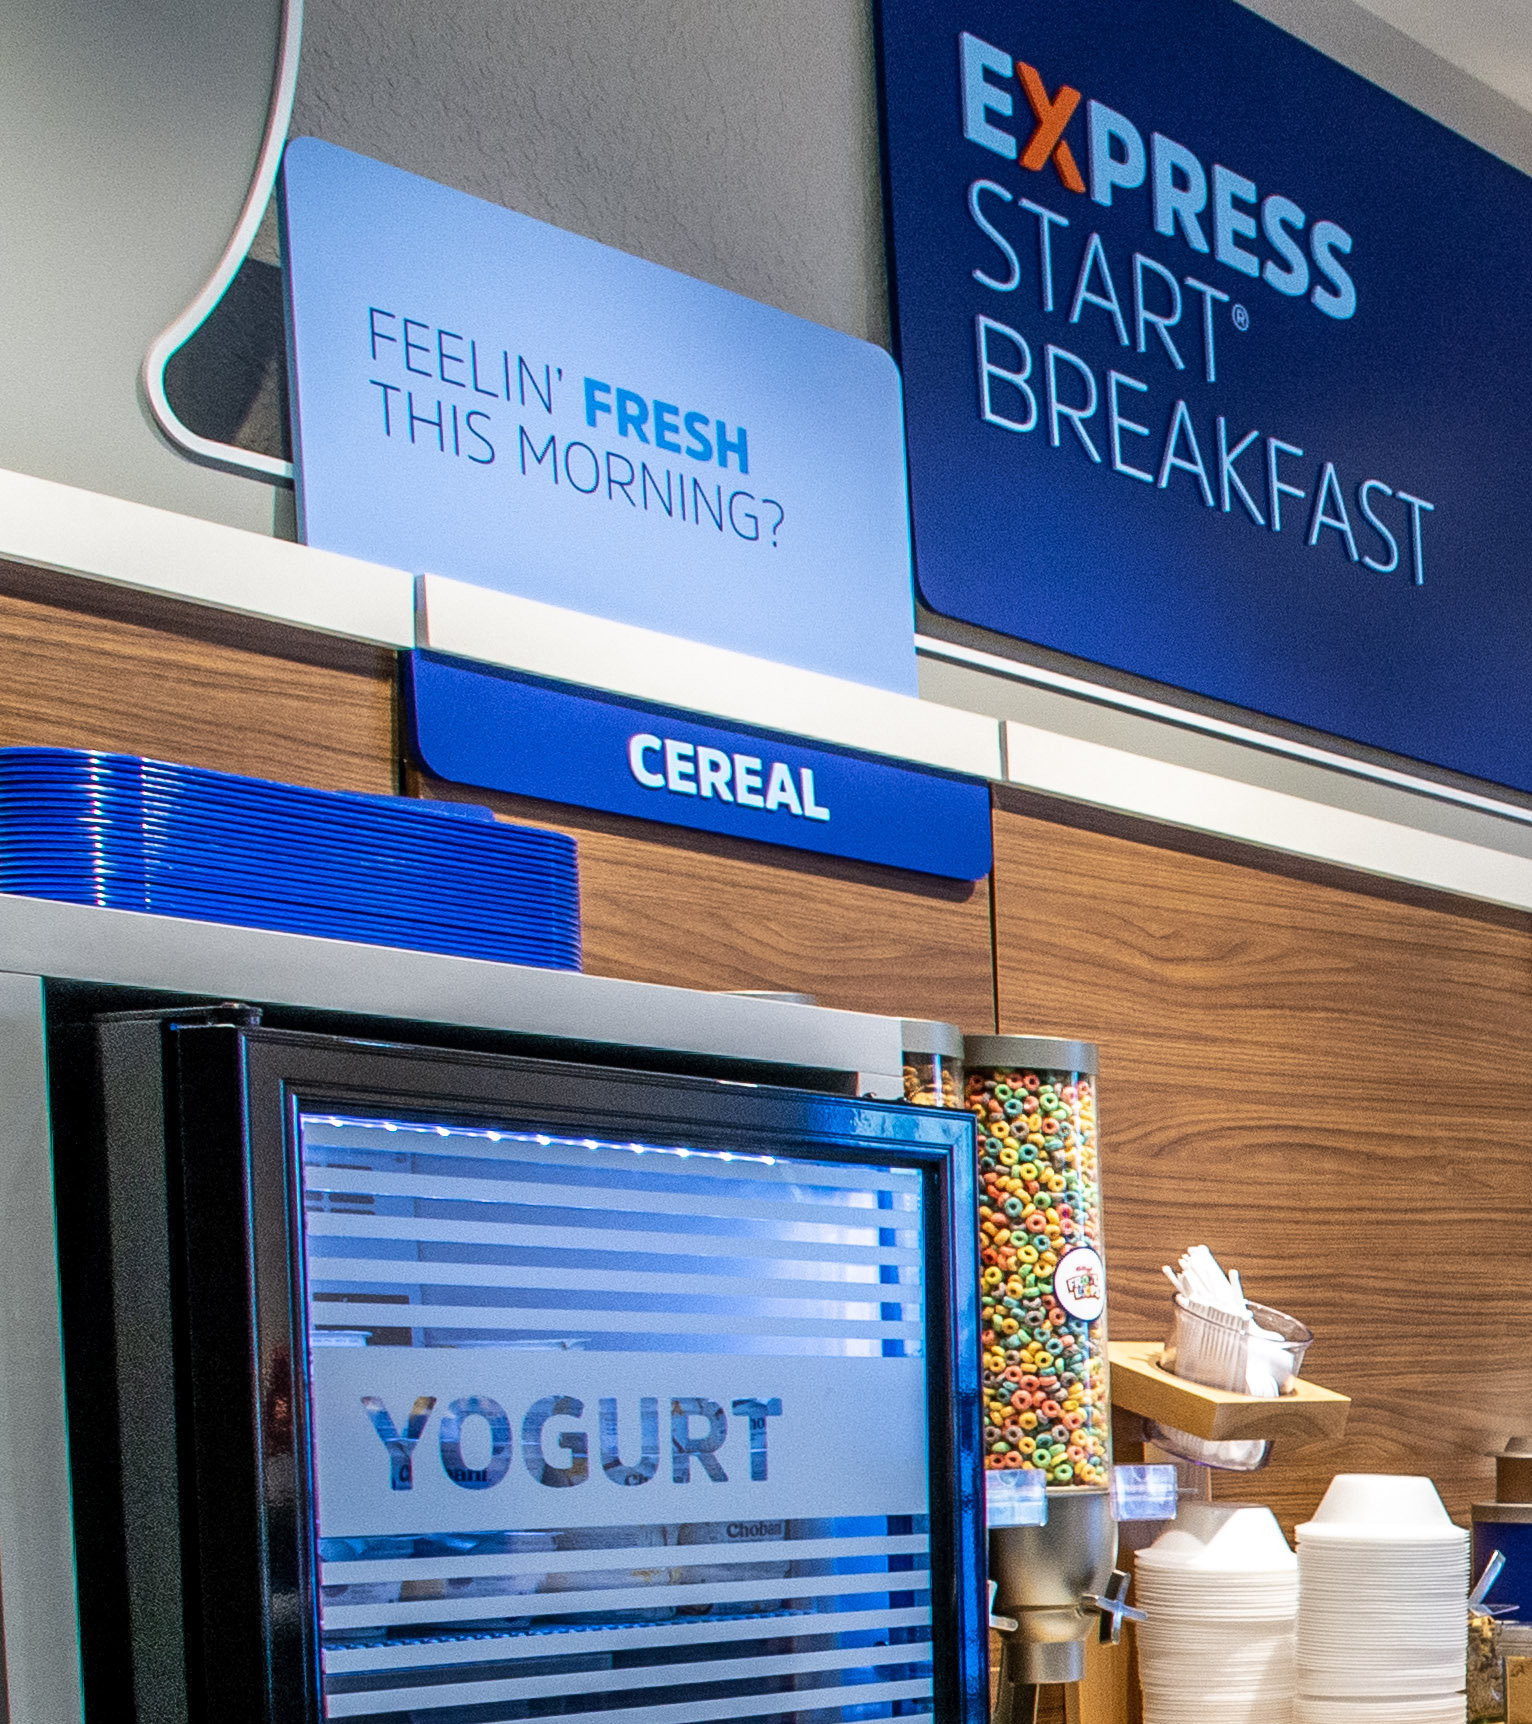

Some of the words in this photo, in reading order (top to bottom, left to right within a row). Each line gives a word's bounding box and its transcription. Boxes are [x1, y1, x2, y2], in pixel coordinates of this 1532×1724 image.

[959, 30, 1357, 320] EXPRESS
[369, 380, 497, 467] THIS
[520, 420, 785, 549] MORNING?
[583, 377, 751, 476] FRESH
[975, 312, 1435, 585] BREAKFAST
[627, 731, 831, 824] CEREAL
[360, 1394, 784, 1492] YOGURT
